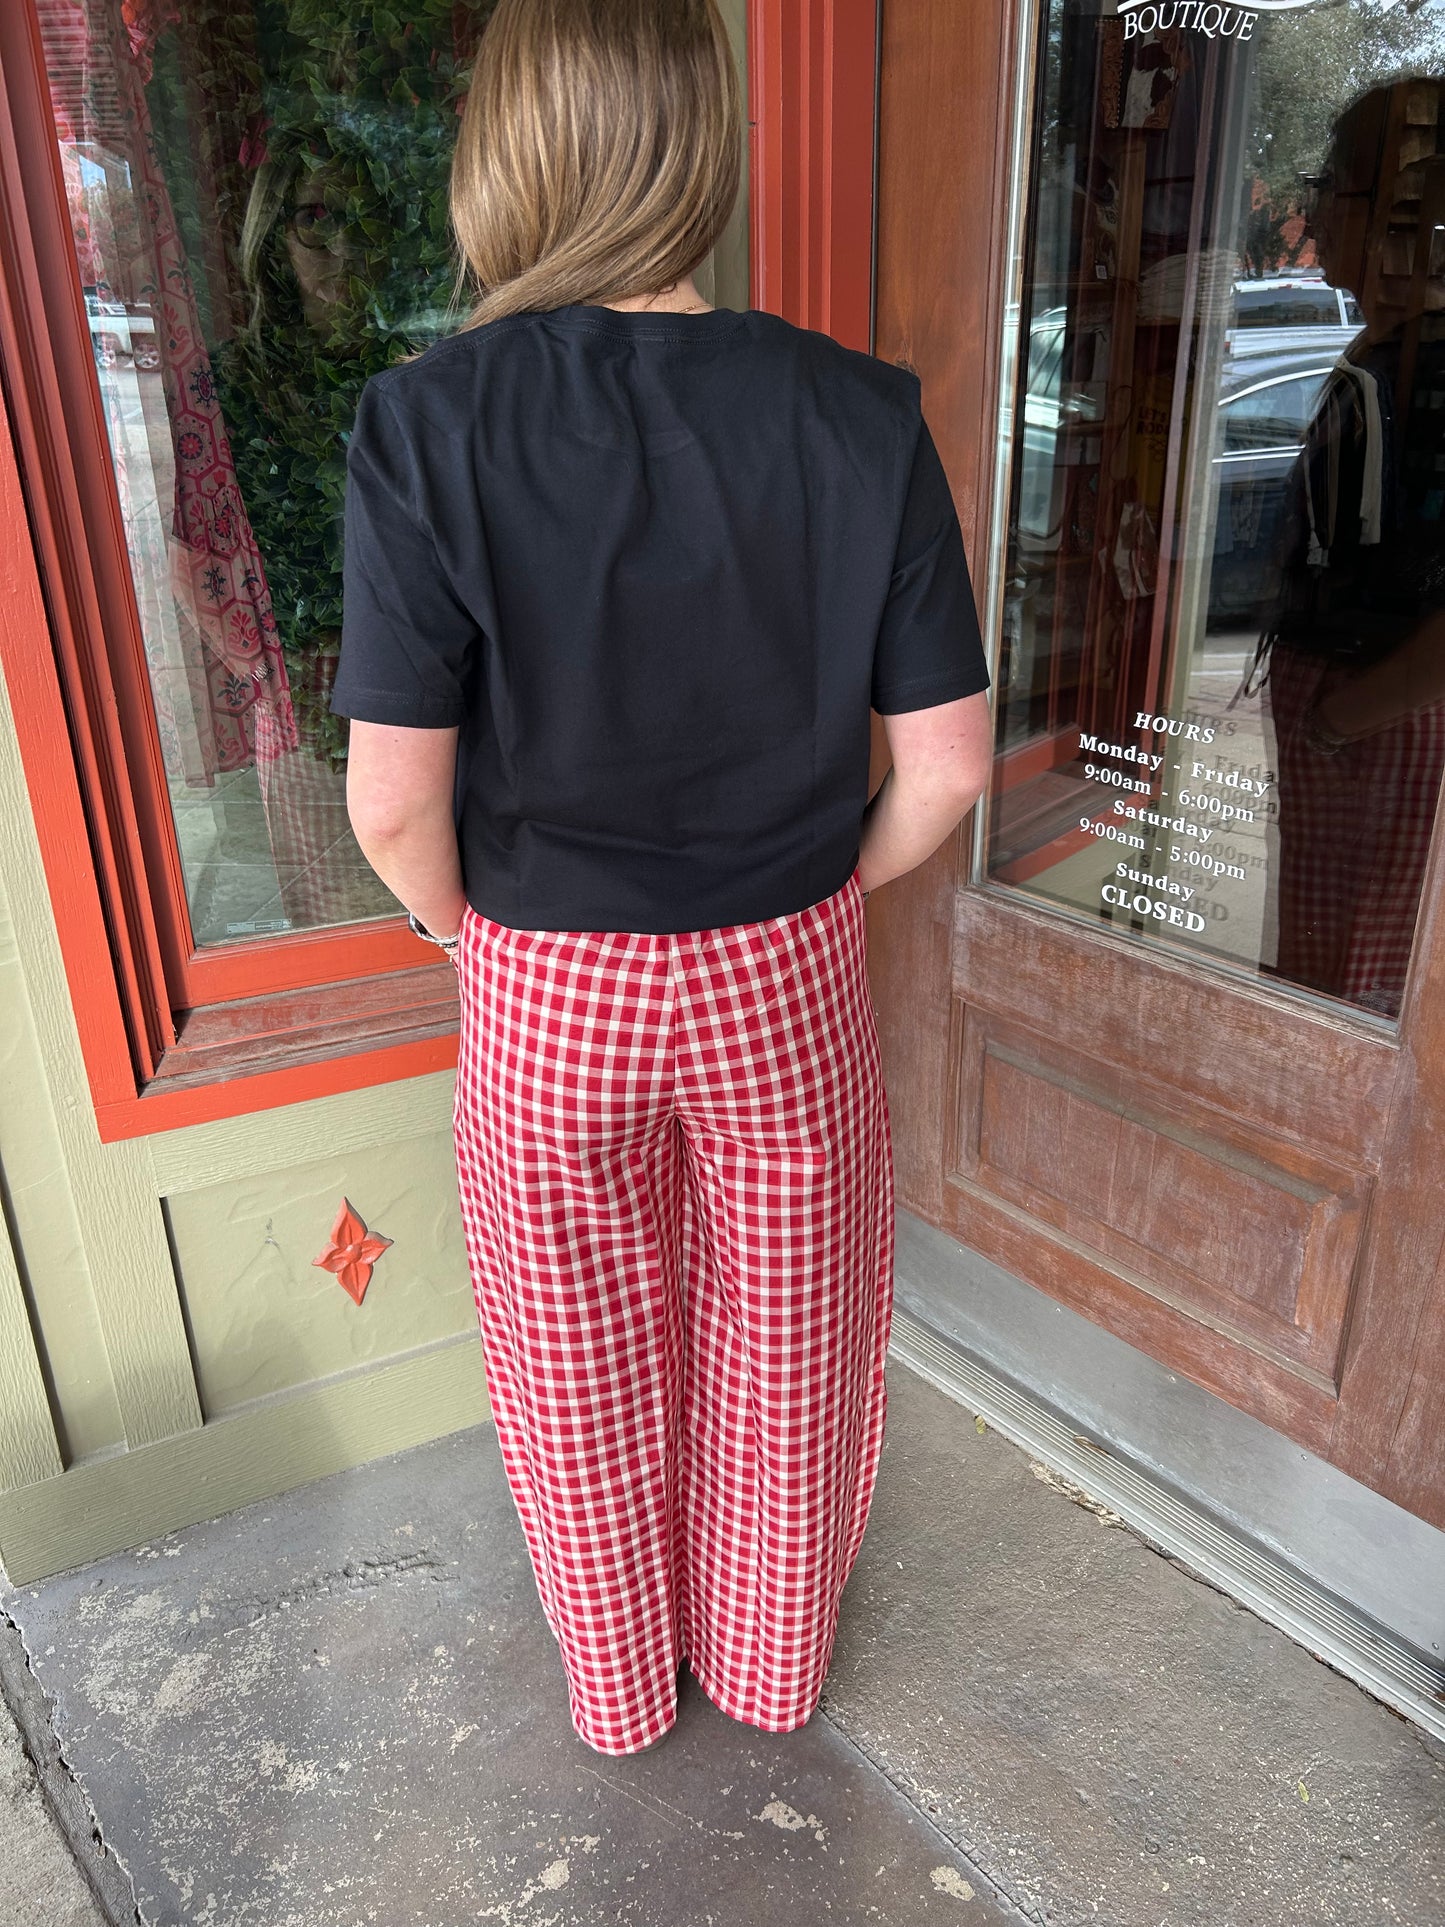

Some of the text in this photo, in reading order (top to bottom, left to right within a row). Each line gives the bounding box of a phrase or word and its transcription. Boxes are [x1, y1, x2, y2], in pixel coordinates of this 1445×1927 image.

[1123, 1, 1259, 41] BOUTIQUE
[1133, 711, 1216, 744] HOURS
[1078, 733, 1164, 772] Monday
[1190, 761, 1270, 798] Friday
[1083, 763, 1152, 796] 9:00am
[1178, 789, 1256, 824] 6:00pm
[1113, 799, 1214, 843] Saturday
[1078, 817, 1146, 850] 9:00am
[1168, 845, 1247, 881] 5:00pm
[1115, 862, 1196, 902] Sunday
[1100, 884, 1207, 934] CLOSED
